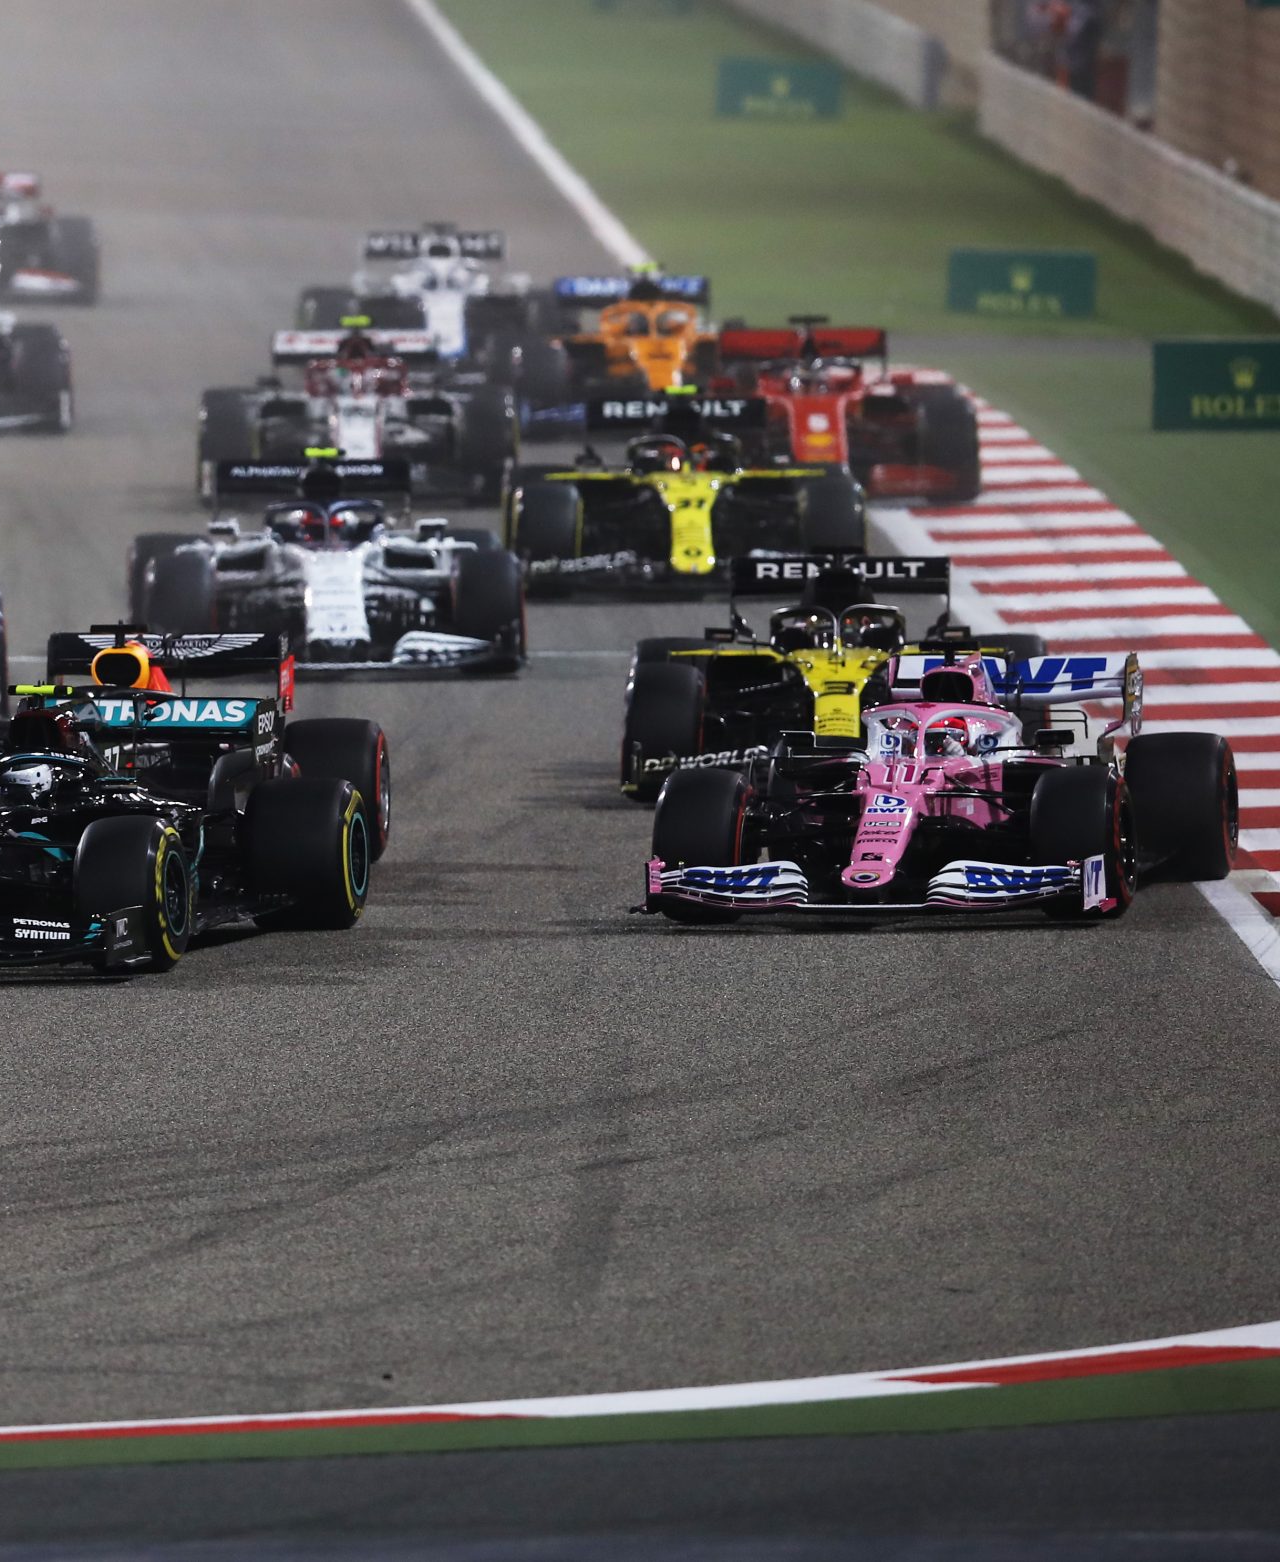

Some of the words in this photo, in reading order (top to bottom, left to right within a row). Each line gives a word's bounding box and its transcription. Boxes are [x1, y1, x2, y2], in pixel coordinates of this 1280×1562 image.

[602, 400, 746, 418] RENULT
[1190, 394, 1280, 418] ROLE
[755, 561, 925, 579] RENULT
[13, 918, 71, 929] PETRONAS
[14, 928, 71, 940] SYNTIUM
